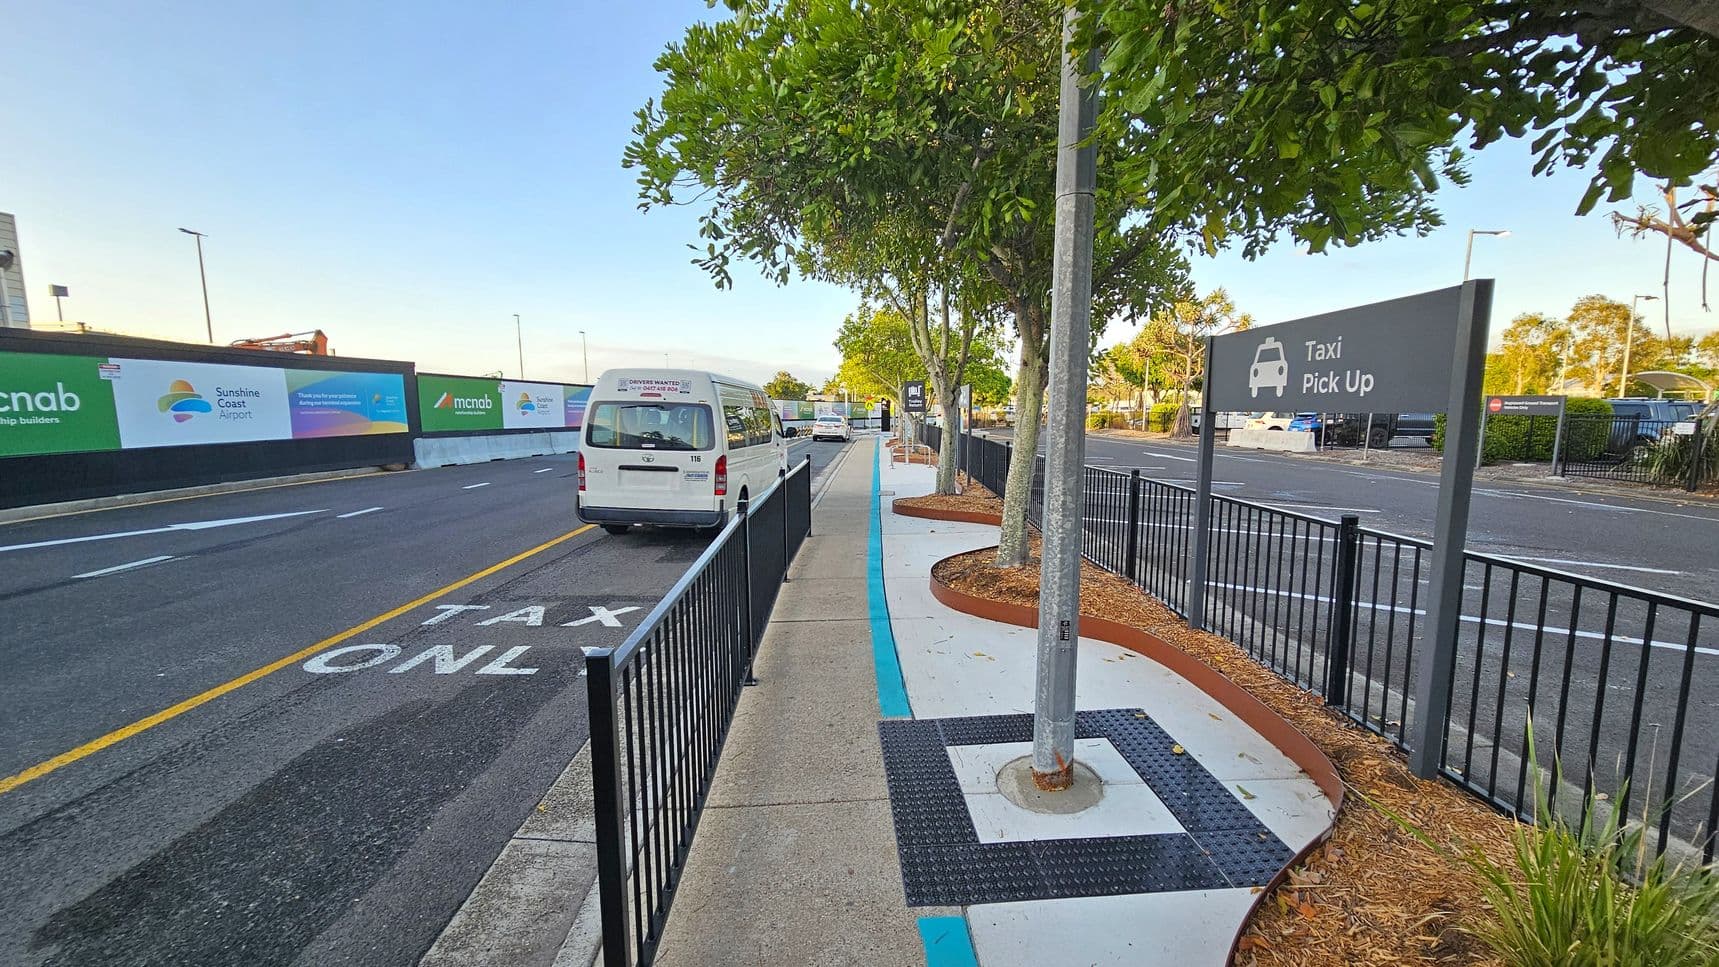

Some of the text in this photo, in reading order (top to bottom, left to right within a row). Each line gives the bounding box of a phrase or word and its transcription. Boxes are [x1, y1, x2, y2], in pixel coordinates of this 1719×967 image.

[1305, 336, 1342, 361] Taxi
[1302, 370, 1374, 397] Pick Up
[216, 387, 260, 398] Sunshine
[217, 398, 246, 408] Coast
[454, 394, 492, 409] mcnab
[19, 416, 60, 425] builders
[219, 410, 253, 421] Airport
[690, 455, 702, 463] 116
[421, 604, 645, 627] TAX
[302, 643, 600, 675] ONL
